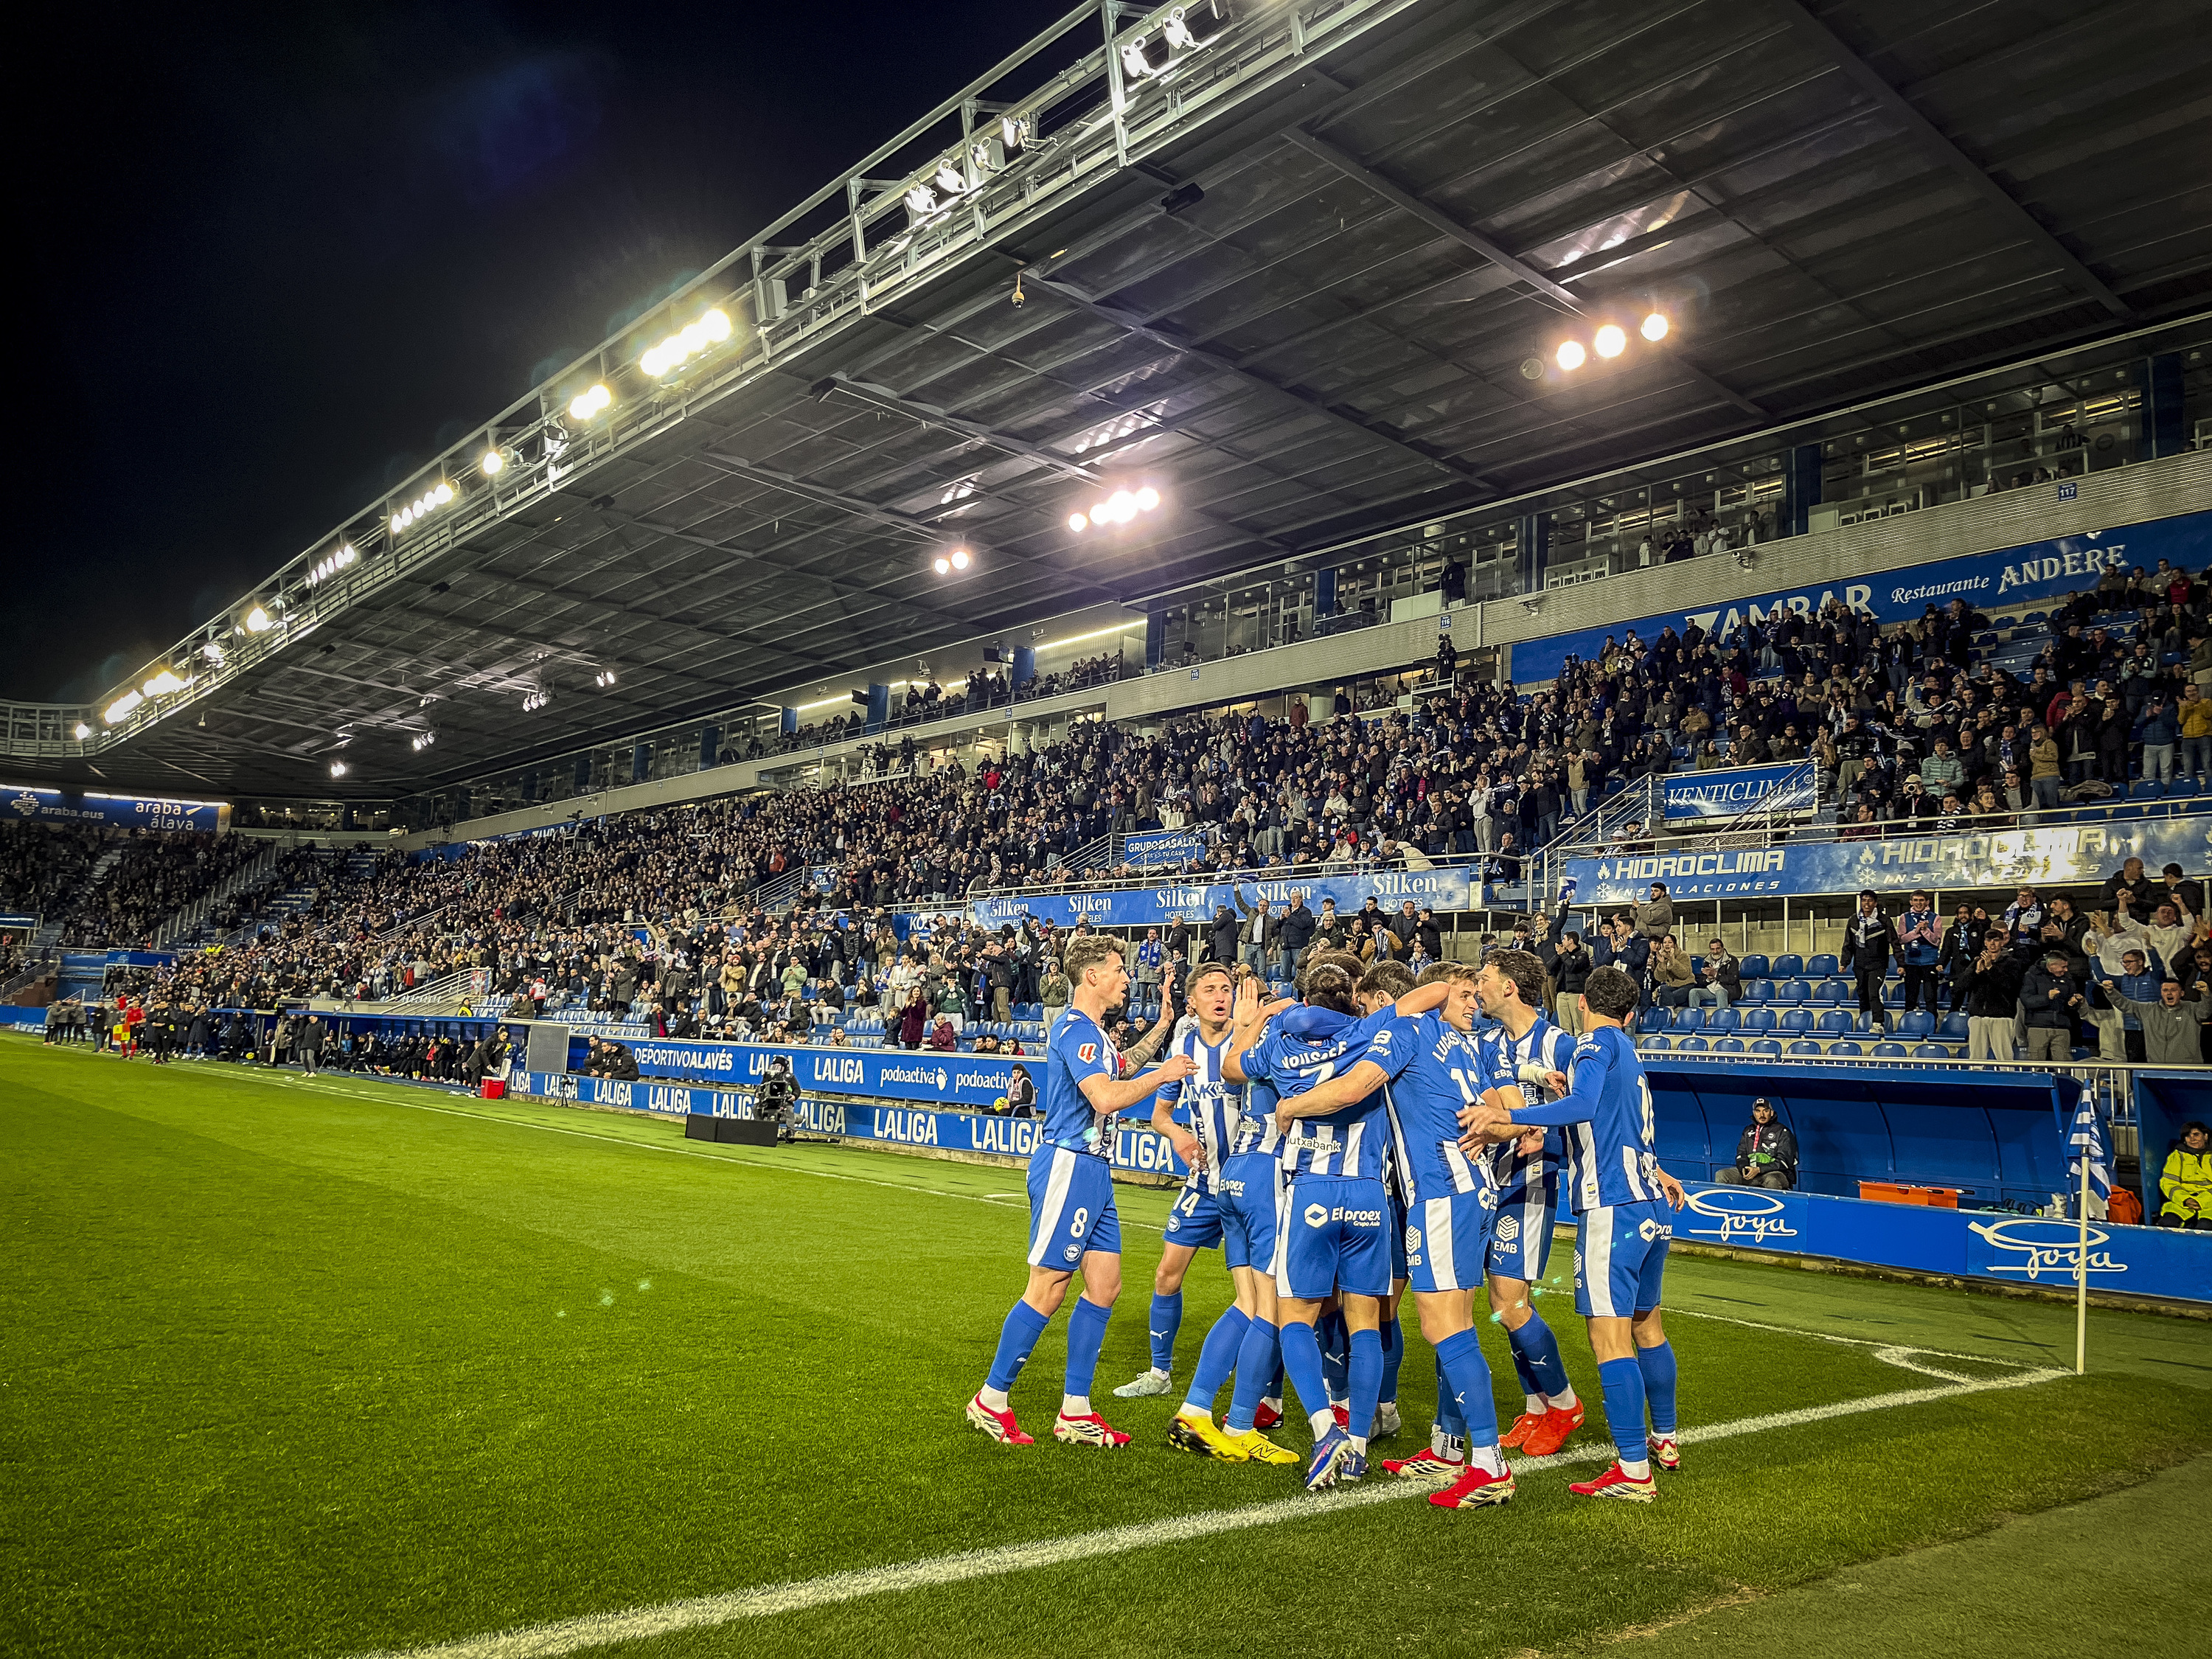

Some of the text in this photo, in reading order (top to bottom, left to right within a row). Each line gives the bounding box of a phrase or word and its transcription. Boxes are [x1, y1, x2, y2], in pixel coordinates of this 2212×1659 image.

[2059, 487, 2075, 497] 117
[1891, 544, 2129, 604] Restaurante ANDERE
[41, 805, 105, 820] araba.eus
[135, 801, 181, 815] araba
[150, 815, 194, 831] álava
[1615, 849, 1785, 880] HIDROCLIMA
[1255, 882, 1312, 902] Silken
[1373, 873, 1438, 895] Silken
[1617, 880, 1780, 897] INSLACIONES
[1068, 894, 1112, 913] Silken
[1156, 887, 1205, 908] Silken
[997, 919, 1020, 928] HOTELES
[1164, 910, 1194, 920] HOTELES
[1432, 1031, 1460, 1063] LUCAS
[634, 1047, 733, 1071] DEPORTIVOALAVÉS
[814, 1057, 864, 1084] LALIGA
[880, 1066, 936, 1088] podoactiva
[1300, 1061, 1335, 1088] 7
[594, 1079, 632, 1106] LALIGA
[648, 1085, 691, 1114] LALIGA
[795, 1102, 846, 1134] ALIGA
[874, 1108, 938, 1145] LALIGA
[1173, 1186, 1200, 1217] 14
[1070, 1207, 1088, 1238] 8
[1494, 1240, 1517, 1253] EMB
